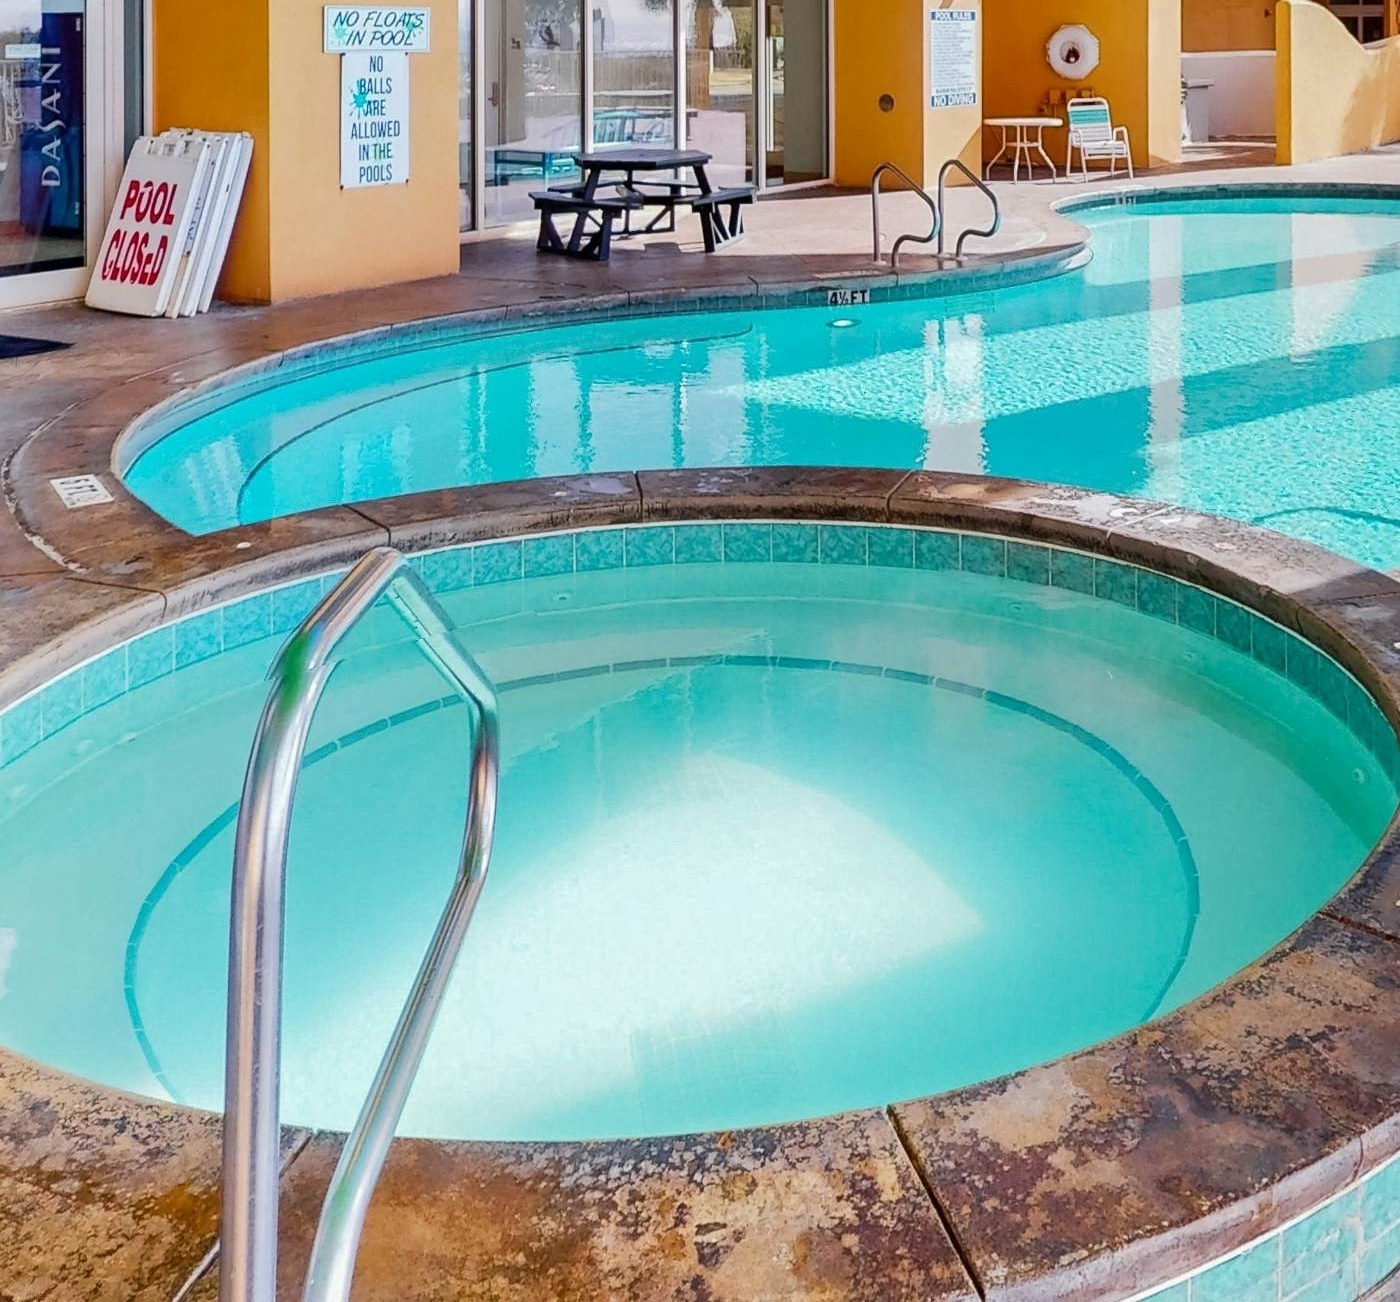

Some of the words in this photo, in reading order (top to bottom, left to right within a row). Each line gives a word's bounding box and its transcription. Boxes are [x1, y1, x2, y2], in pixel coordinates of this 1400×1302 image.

[333, 10, 360, 27] NO
[363, 11, 425, 28] FLOATS
[346, 30, 367, 46] IN
[369, 29, 414, 46] POOL
[369, 55, 384, 73] NO
[359, 77, 393, 95] BALLS
[365, 99, 386, 116] ARE
[934, 95, 947, 107] NO
[948, 93, 974, 106] DIVING
[39, 47, 66, 187] DASANI
[350, 120, 401, 140] ALLOWED
[358, 143, 370, 161] IN
[373, 142, 393, 159] THE
[359, 164, 393, 184] POOLS
[120, 180, 178, 225] POOL
[102, 229, 169, 286] CLOSED
[851, 289, 867, 304] FT
